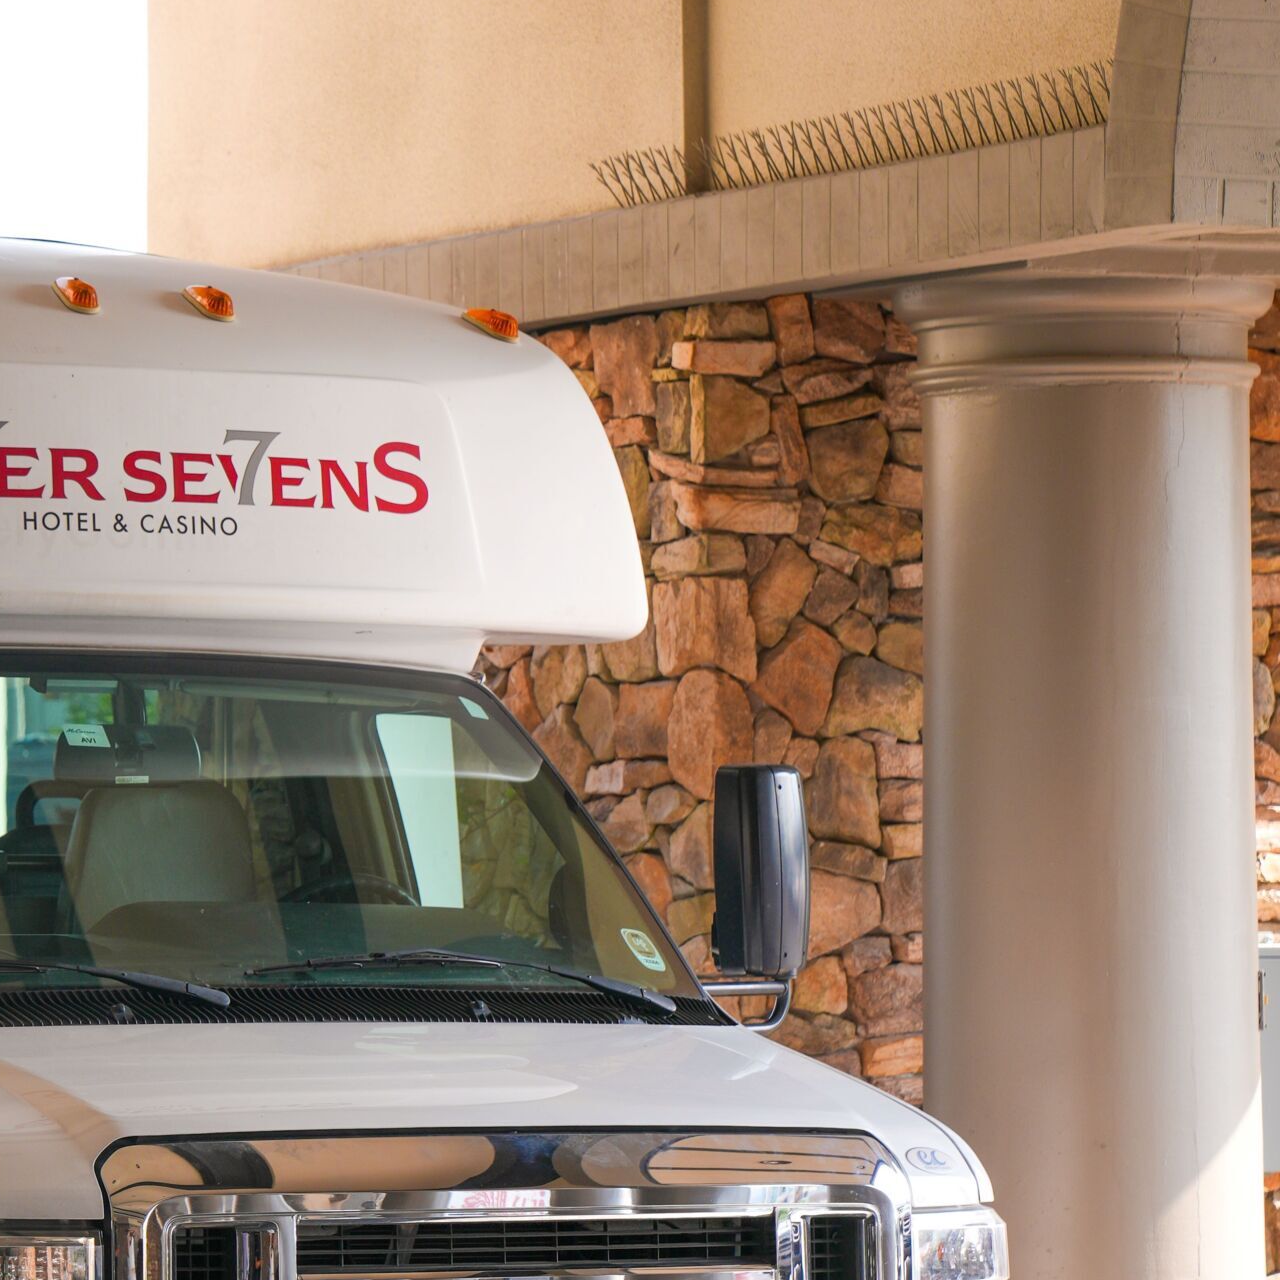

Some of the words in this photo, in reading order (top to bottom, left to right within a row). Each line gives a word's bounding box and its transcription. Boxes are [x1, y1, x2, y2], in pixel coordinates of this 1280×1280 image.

[22, 511, 102, 532] HOTEL
[112, 513, 129, 533] &
[139, 513, 239, 537] CASINO
[80, 736, 98, 745] AVI
